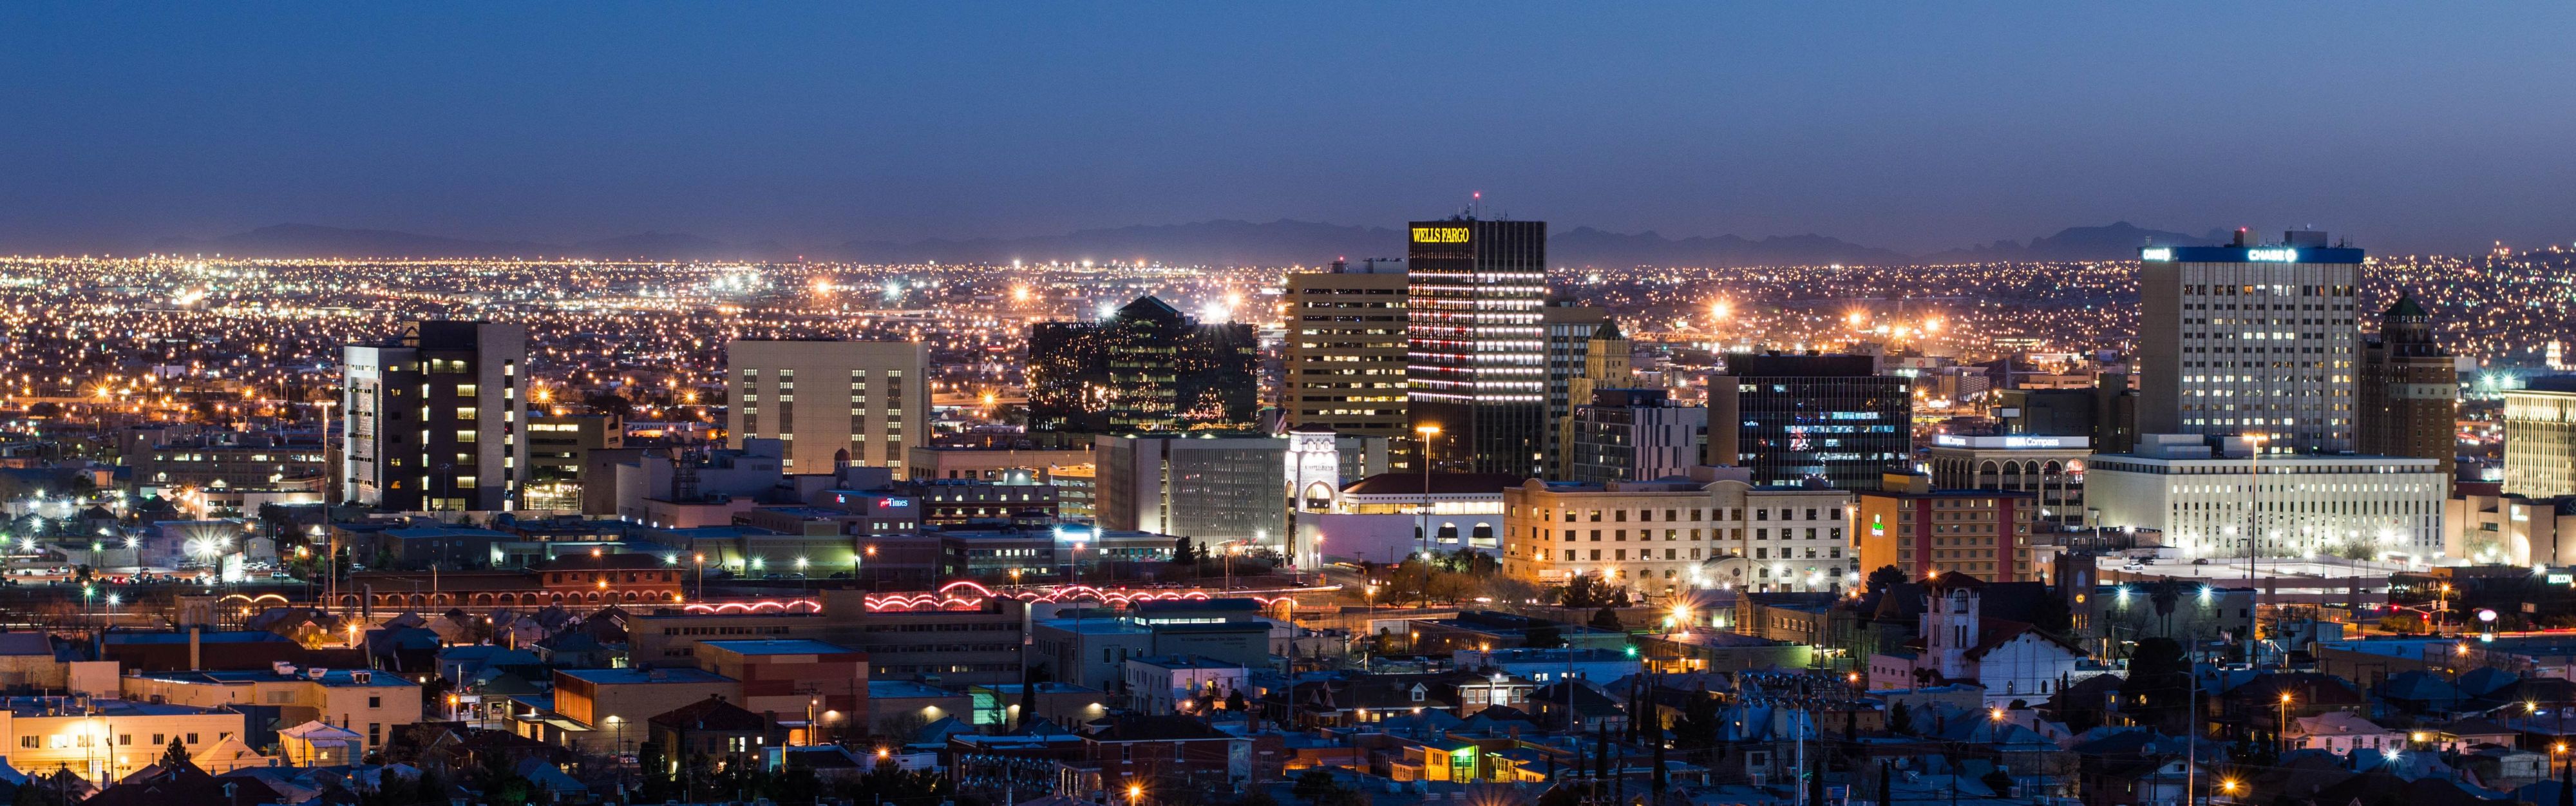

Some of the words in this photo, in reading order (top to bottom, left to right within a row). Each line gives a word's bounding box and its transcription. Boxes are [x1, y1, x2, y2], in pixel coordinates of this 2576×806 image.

[1412, 227, 1441, 242] WELLS
[1441, 227, 1469, 242] FARGO
[2248, 249, 2285, 260] CHASE
[2026, 437, 2060, 447] Compass
[887, 498, 908, 506] Times
